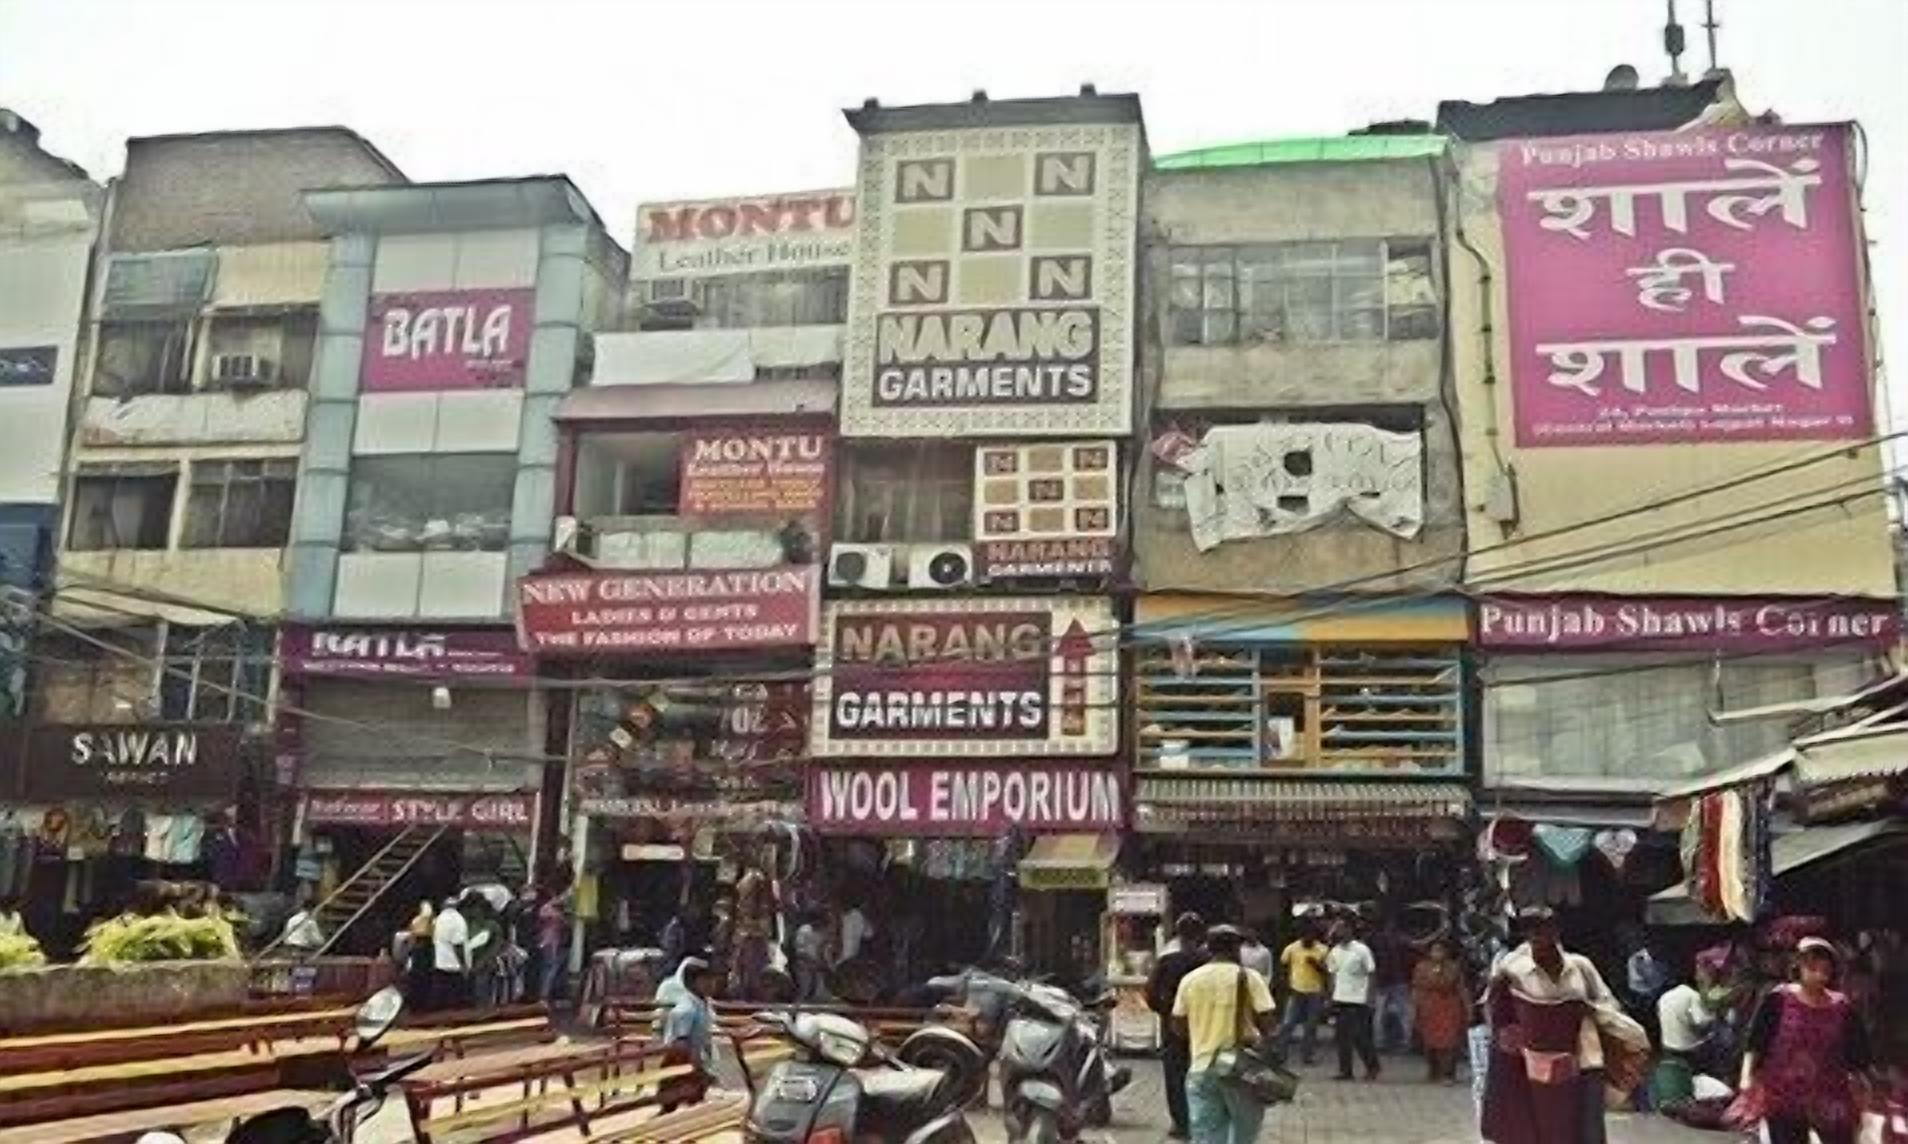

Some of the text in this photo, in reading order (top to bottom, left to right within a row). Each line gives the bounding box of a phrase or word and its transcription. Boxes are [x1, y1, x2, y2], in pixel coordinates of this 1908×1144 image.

[1520, 132, 1824, 168] Punjab Shawls Corner
[900, 163, 948, 198] N
[1041, 155, 1090, 192] N
[1527, 158, 1823, 240] शालें
[648, 197, 855, 244] MONTU
[969, 209, 1018, 248] N
[896, 264, 944, 301] N
[1037, 257, 1086, 297] N
[1625, 248, 1736, 312] ही
[382, 303, 513, 361] BATLA
[878, 310, 1093, 364] NARANG
[1535, 315, 1838, 396] शालें
[878, 365, 1093, 400] GARMENTS
[694, 436, 825, 460] MONTU
[523, 571, 807, 605] NEW GENERATION
[572, 608, 652, 625] LADIES
[684, 603, 758, 622] GENTS
[1481, 603, 1890, 643] Punjab Shawls Corner
[535, 623, 799, 647] THE FASHION OF TODAY
[841, 624, 1041, 665] NARANG
[836, 692, 1043, 728] GARMENTS
[71, 731, 198, 766] SAWAN
[392, 799, 464, 821] STYLE
[471, 798, 528, 821] GIRL
[820, 770, 1121, 822] WOOL EMPORIUM
